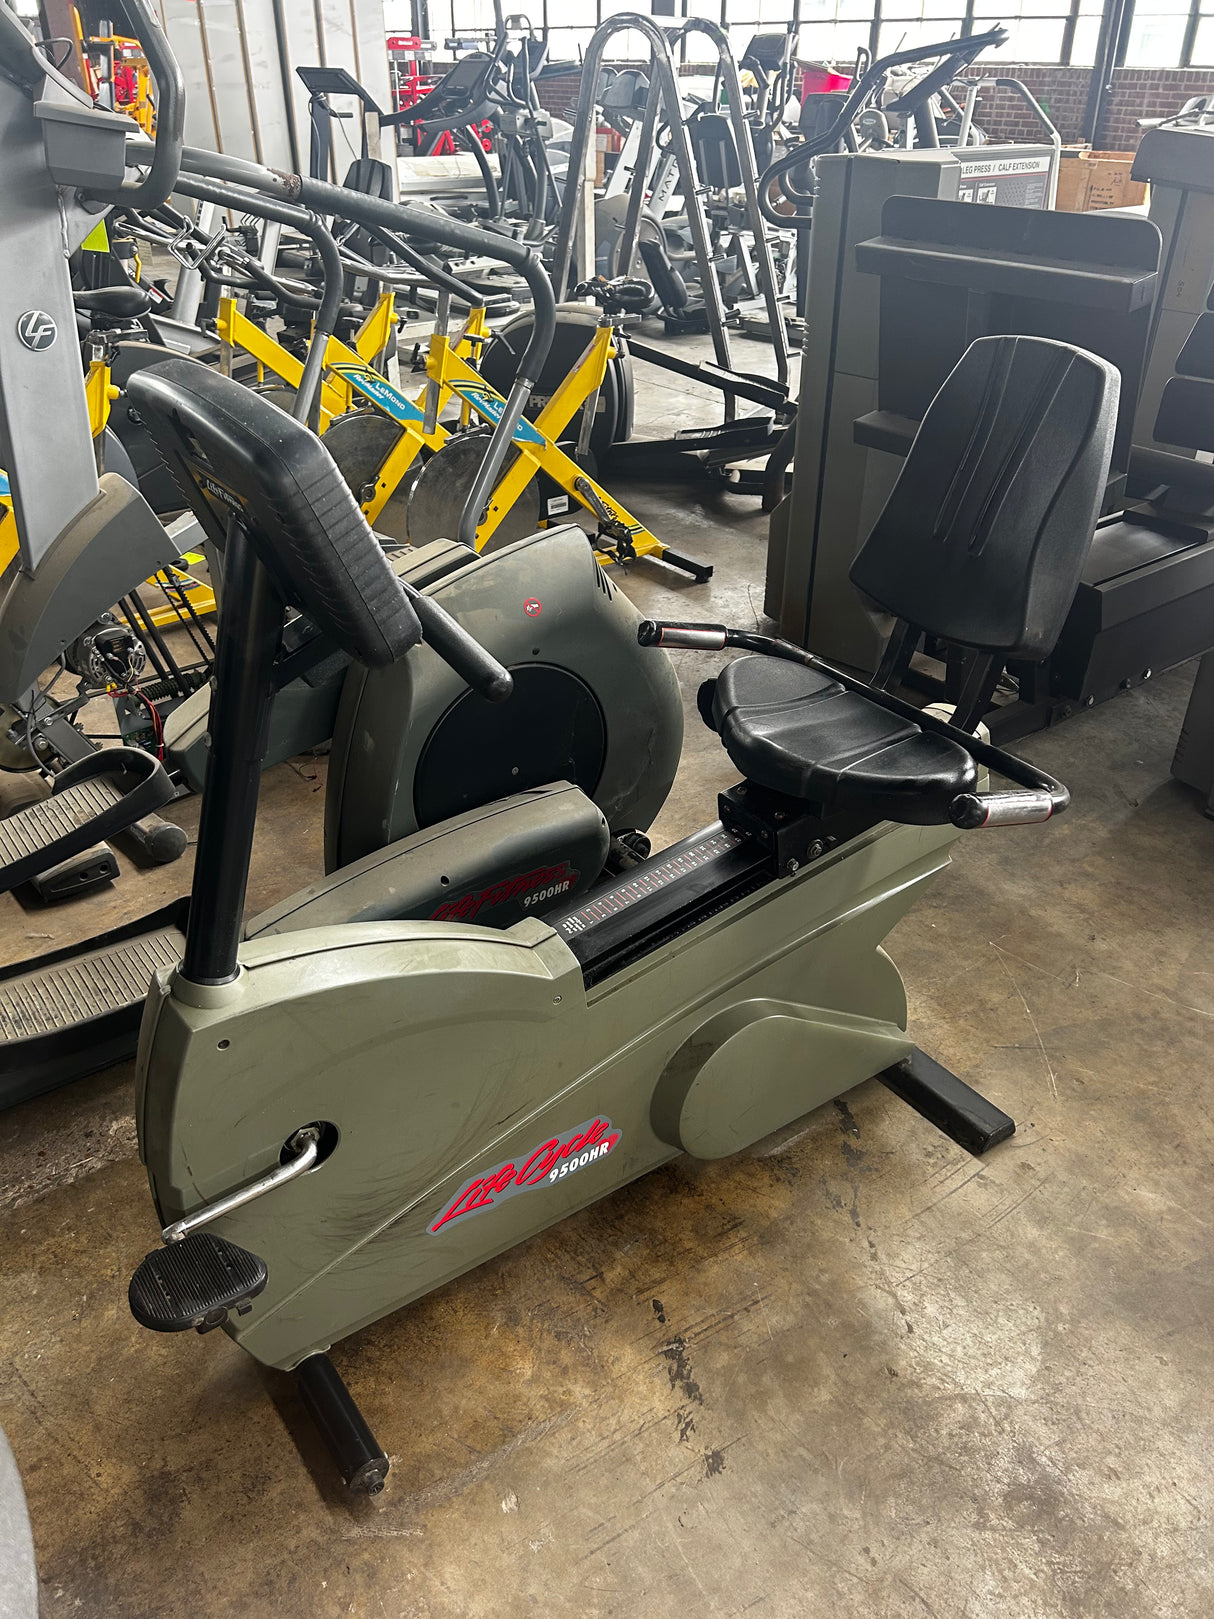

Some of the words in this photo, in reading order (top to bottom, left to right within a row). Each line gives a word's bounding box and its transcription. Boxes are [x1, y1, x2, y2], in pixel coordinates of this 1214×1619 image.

[962, 166, 973, 175] LEG
[974, 164, 991, 173] PRESS
[998, 162, 1012, 172] CALF
[1012, 161, 1040, 170] EXTENSION
[523, 880, 570, 908] 9500HR
[549, 1141, 610, 1184] 9500HR
